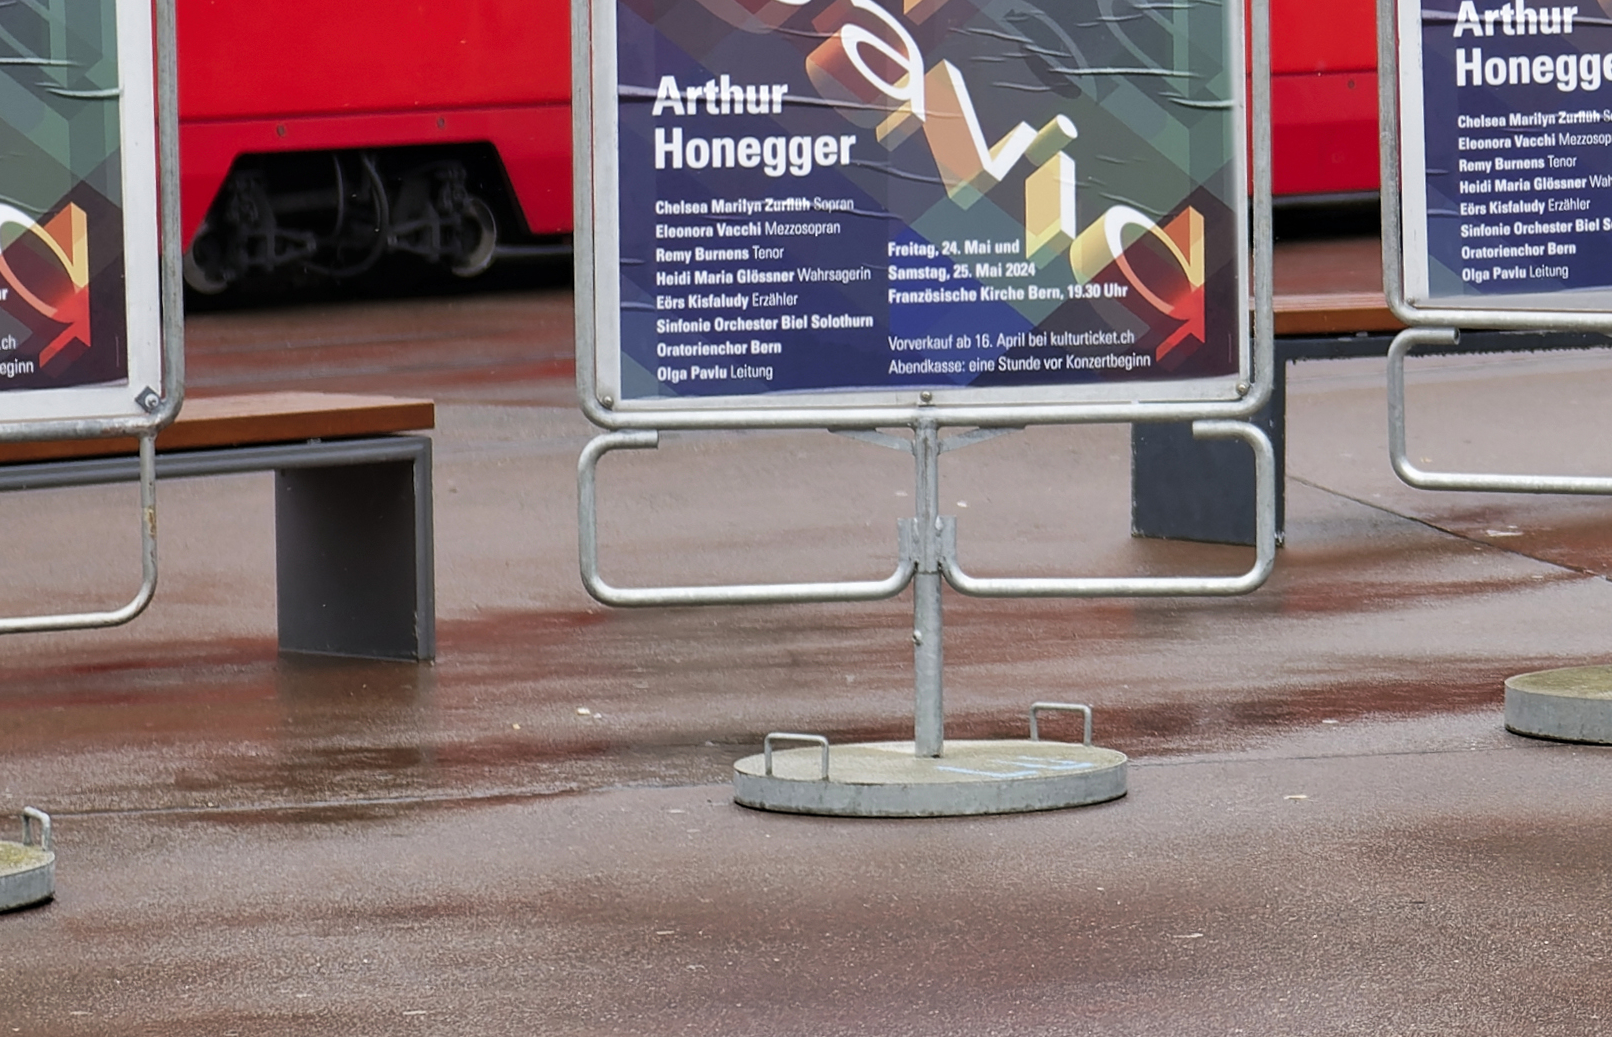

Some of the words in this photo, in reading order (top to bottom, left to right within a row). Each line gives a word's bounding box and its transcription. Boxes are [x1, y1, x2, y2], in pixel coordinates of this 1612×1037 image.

[652, 73, 789, 116] Arthur
[654, 127, 856, 177] Honegger
[1458, 158, 1492, 174] Remy
[1494, 156, 1545, 171] Burnens
[1547, 154, 1577, 168] Tenor
[1459, 202, 1487, 216] Eörs
[1488, 198, 1545, 215] Kisfaludy
[1547, 197, 1591, 212] Erzähler
[887, 241, 939, 259] Freitag,
[941, 240, 961, 255] 24.
[963, 239, 991, 255] Mai
[994, 238, 1020, 254] und
[887, 264, 951, 282] Samstag,
[952, 263, 972, 279] 25.
[975, 262, 1002, 278] Mai
[1005, 261, 1036, 277] 2024
